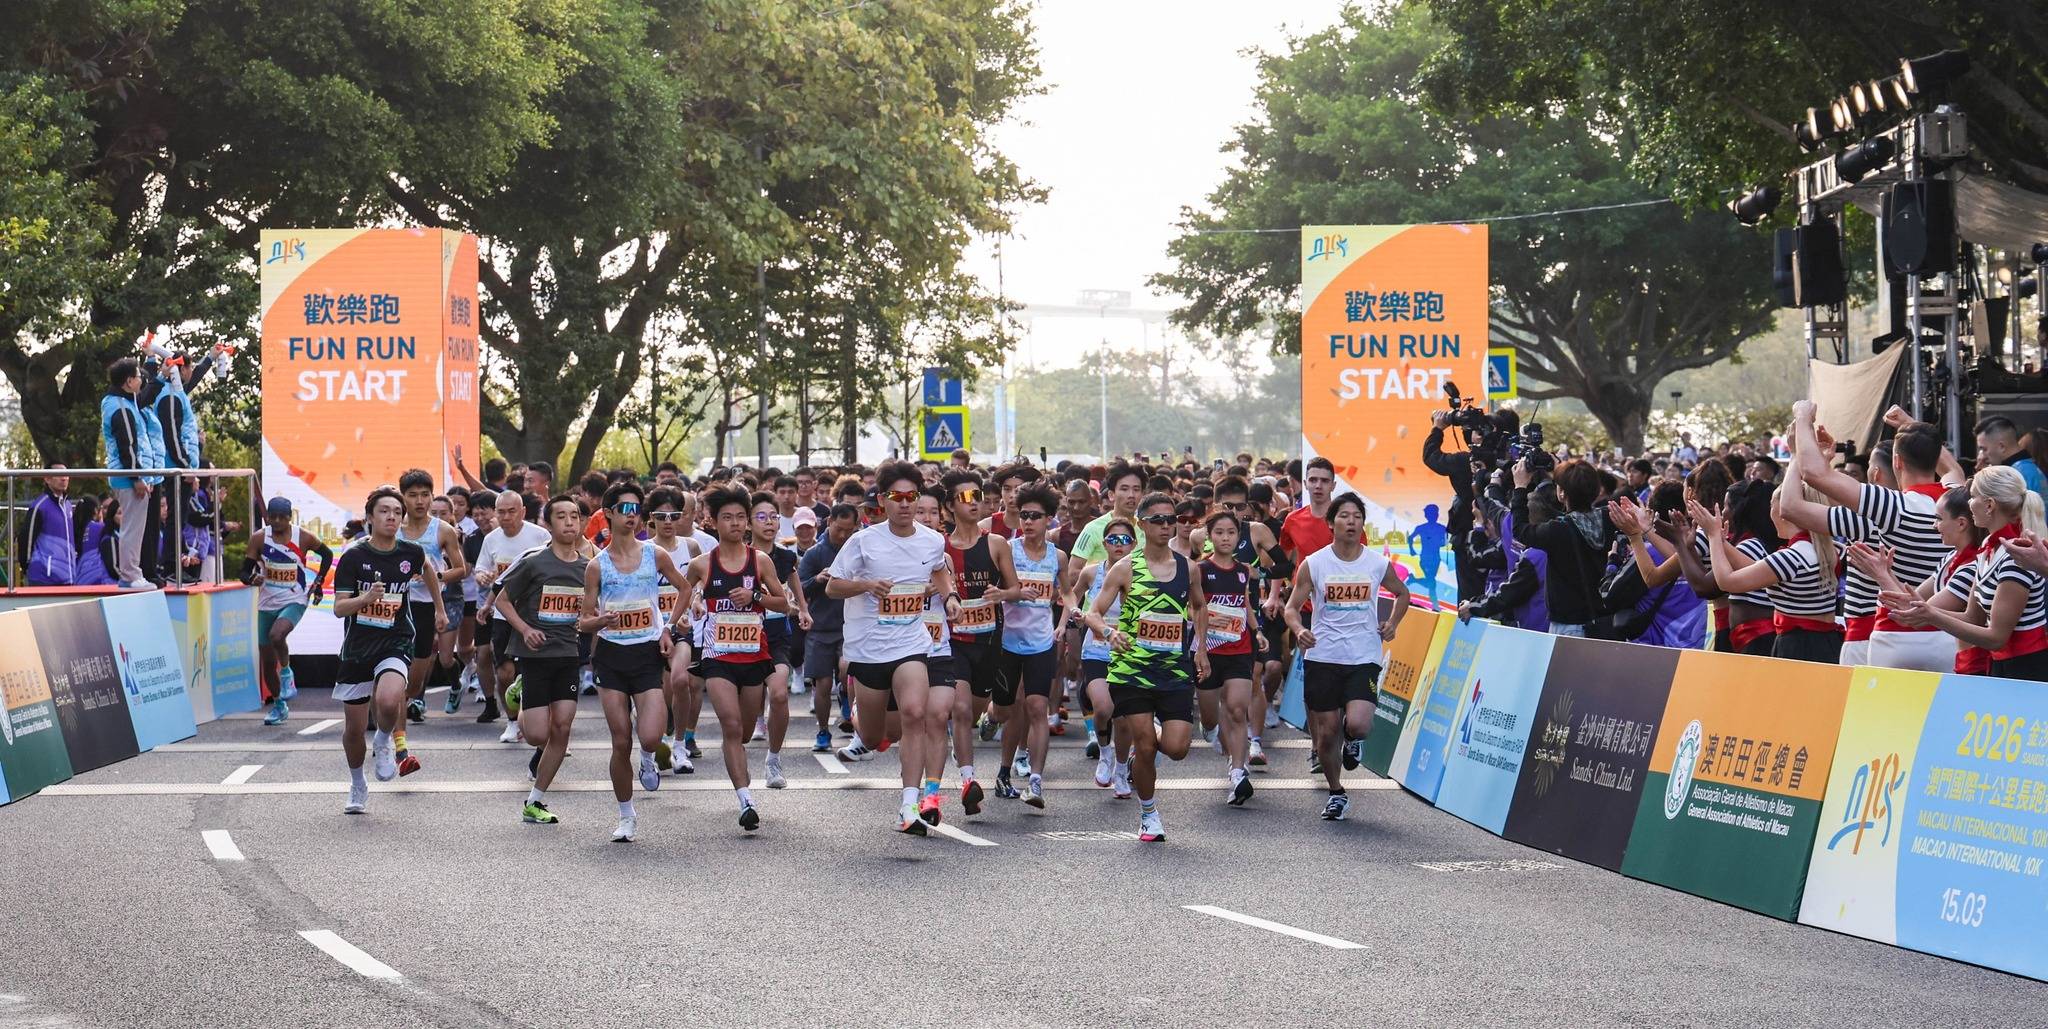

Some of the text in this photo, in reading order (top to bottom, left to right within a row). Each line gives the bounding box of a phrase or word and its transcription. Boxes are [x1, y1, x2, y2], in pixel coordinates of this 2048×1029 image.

[303, 293, 401, 326] 歡樂跑
[1345, 290, 1444, 323] 歡樂跑
[289, 336, 415, 361] FUN RUN
[448, 336, 475, 362] FUN RUN
[1330, 333, 1460, 359] FUN RUN
[297, 369, 407, 402] START
[450, 370, 473, 401] START
[1339, 367, 1452, 400] START
[542, 596, 578, 611] B1044
[883, 596, 922, 613] B1122
[1327, 585, 1369, 600] B2447
[718, 626, 758, 641] B1202
[1140, 622, 1181, 640] B2055
[1575, 713, 1653, 757] 金沙中國有限公司
[1956, 711, 2026, 763] 2026
[1570, 757, 1635, 791] Sands China Ltd.
[1699, 733, 1808, 791] 澳門田徑總會
[1924, 766, 2048, 814] 澳門國際十公里長跑
[1918, 809, 1951, 832] MACAU
[1952, 815, 2028, 846] INTERNACIONAL
[1911, 835, 2044, 877] MACAO INTERNATIONAL 10K
[1941, 887, 1987, 928] 15.03
